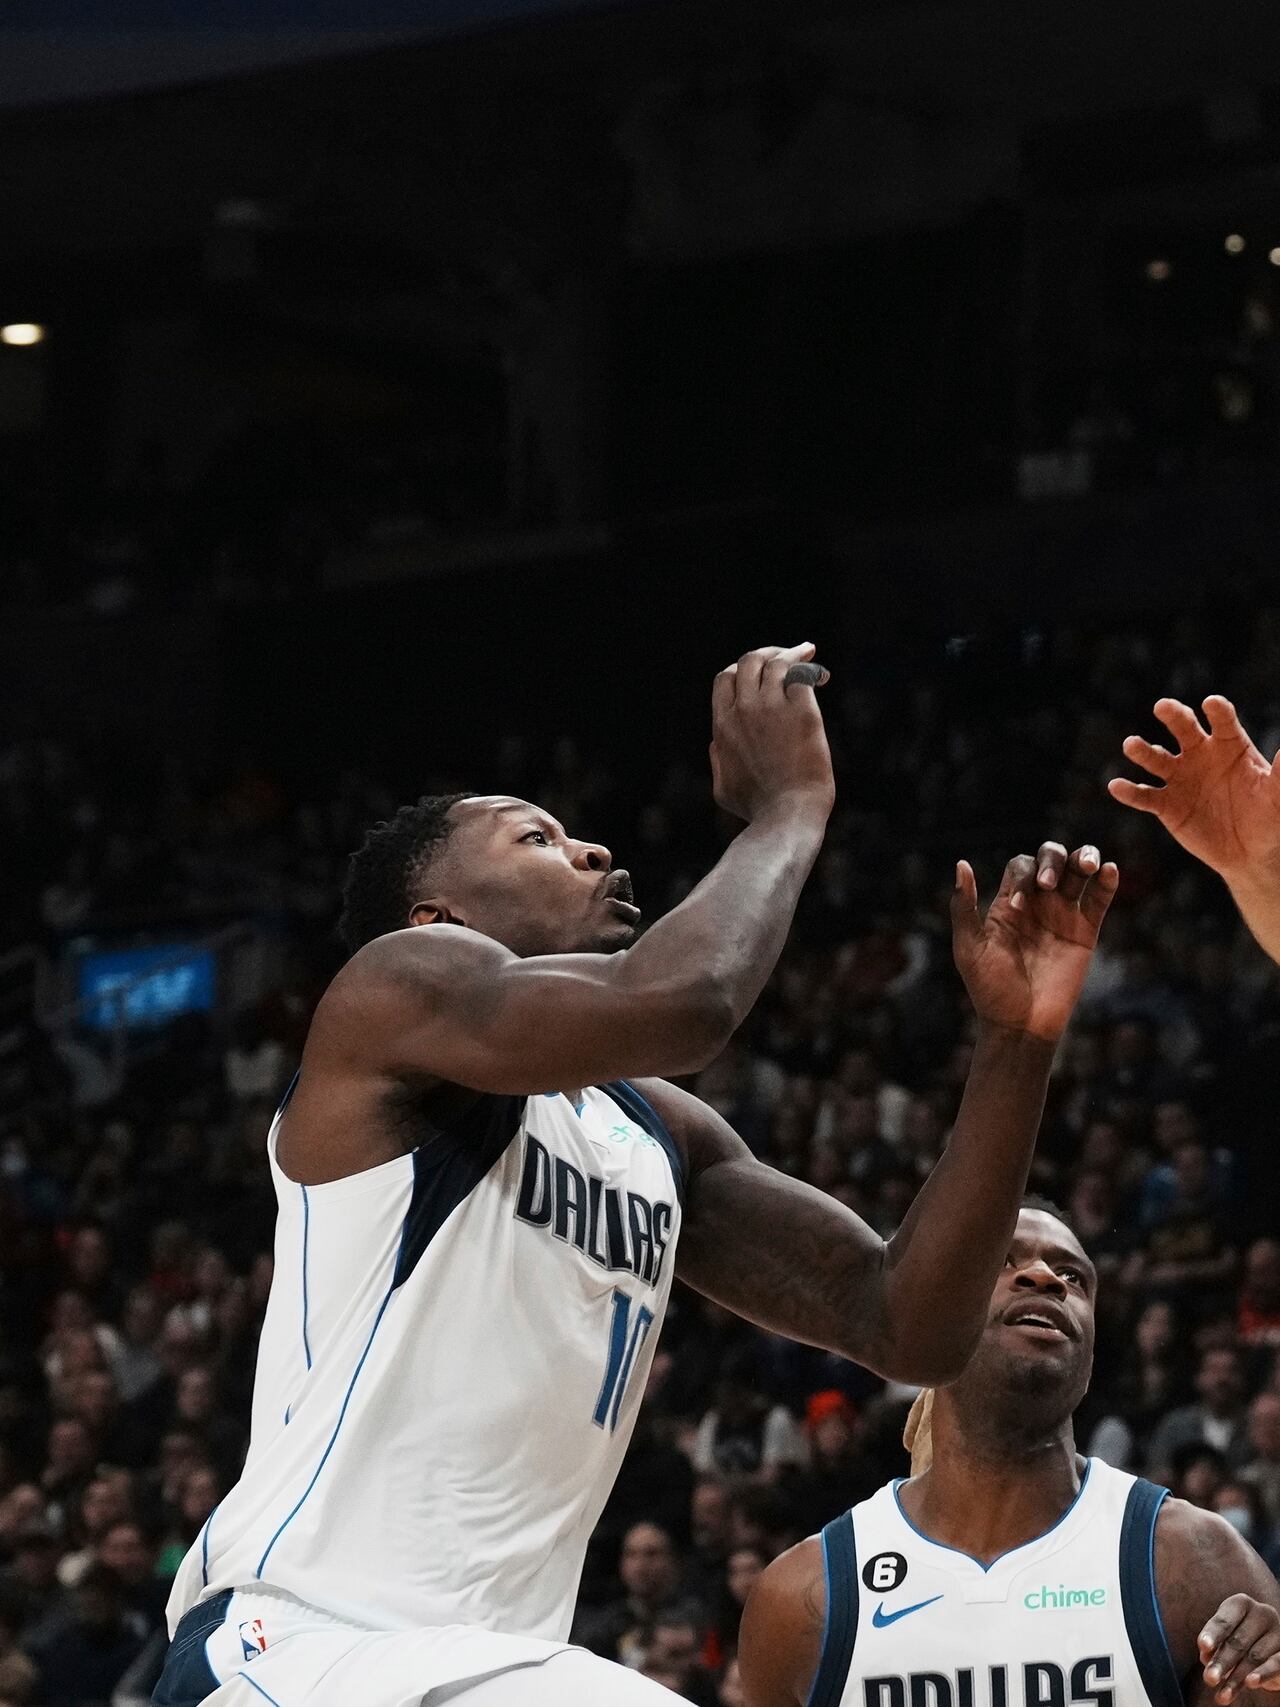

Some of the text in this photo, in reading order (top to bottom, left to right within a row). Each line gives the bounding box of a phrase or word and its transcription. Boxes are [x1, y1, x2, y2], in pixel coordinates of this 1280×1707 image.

[513, 1131, 673, 1291] DALLAS
[871, 1556, 898, 1589] 6
[1023, 1584, 1106, 1610] chime
